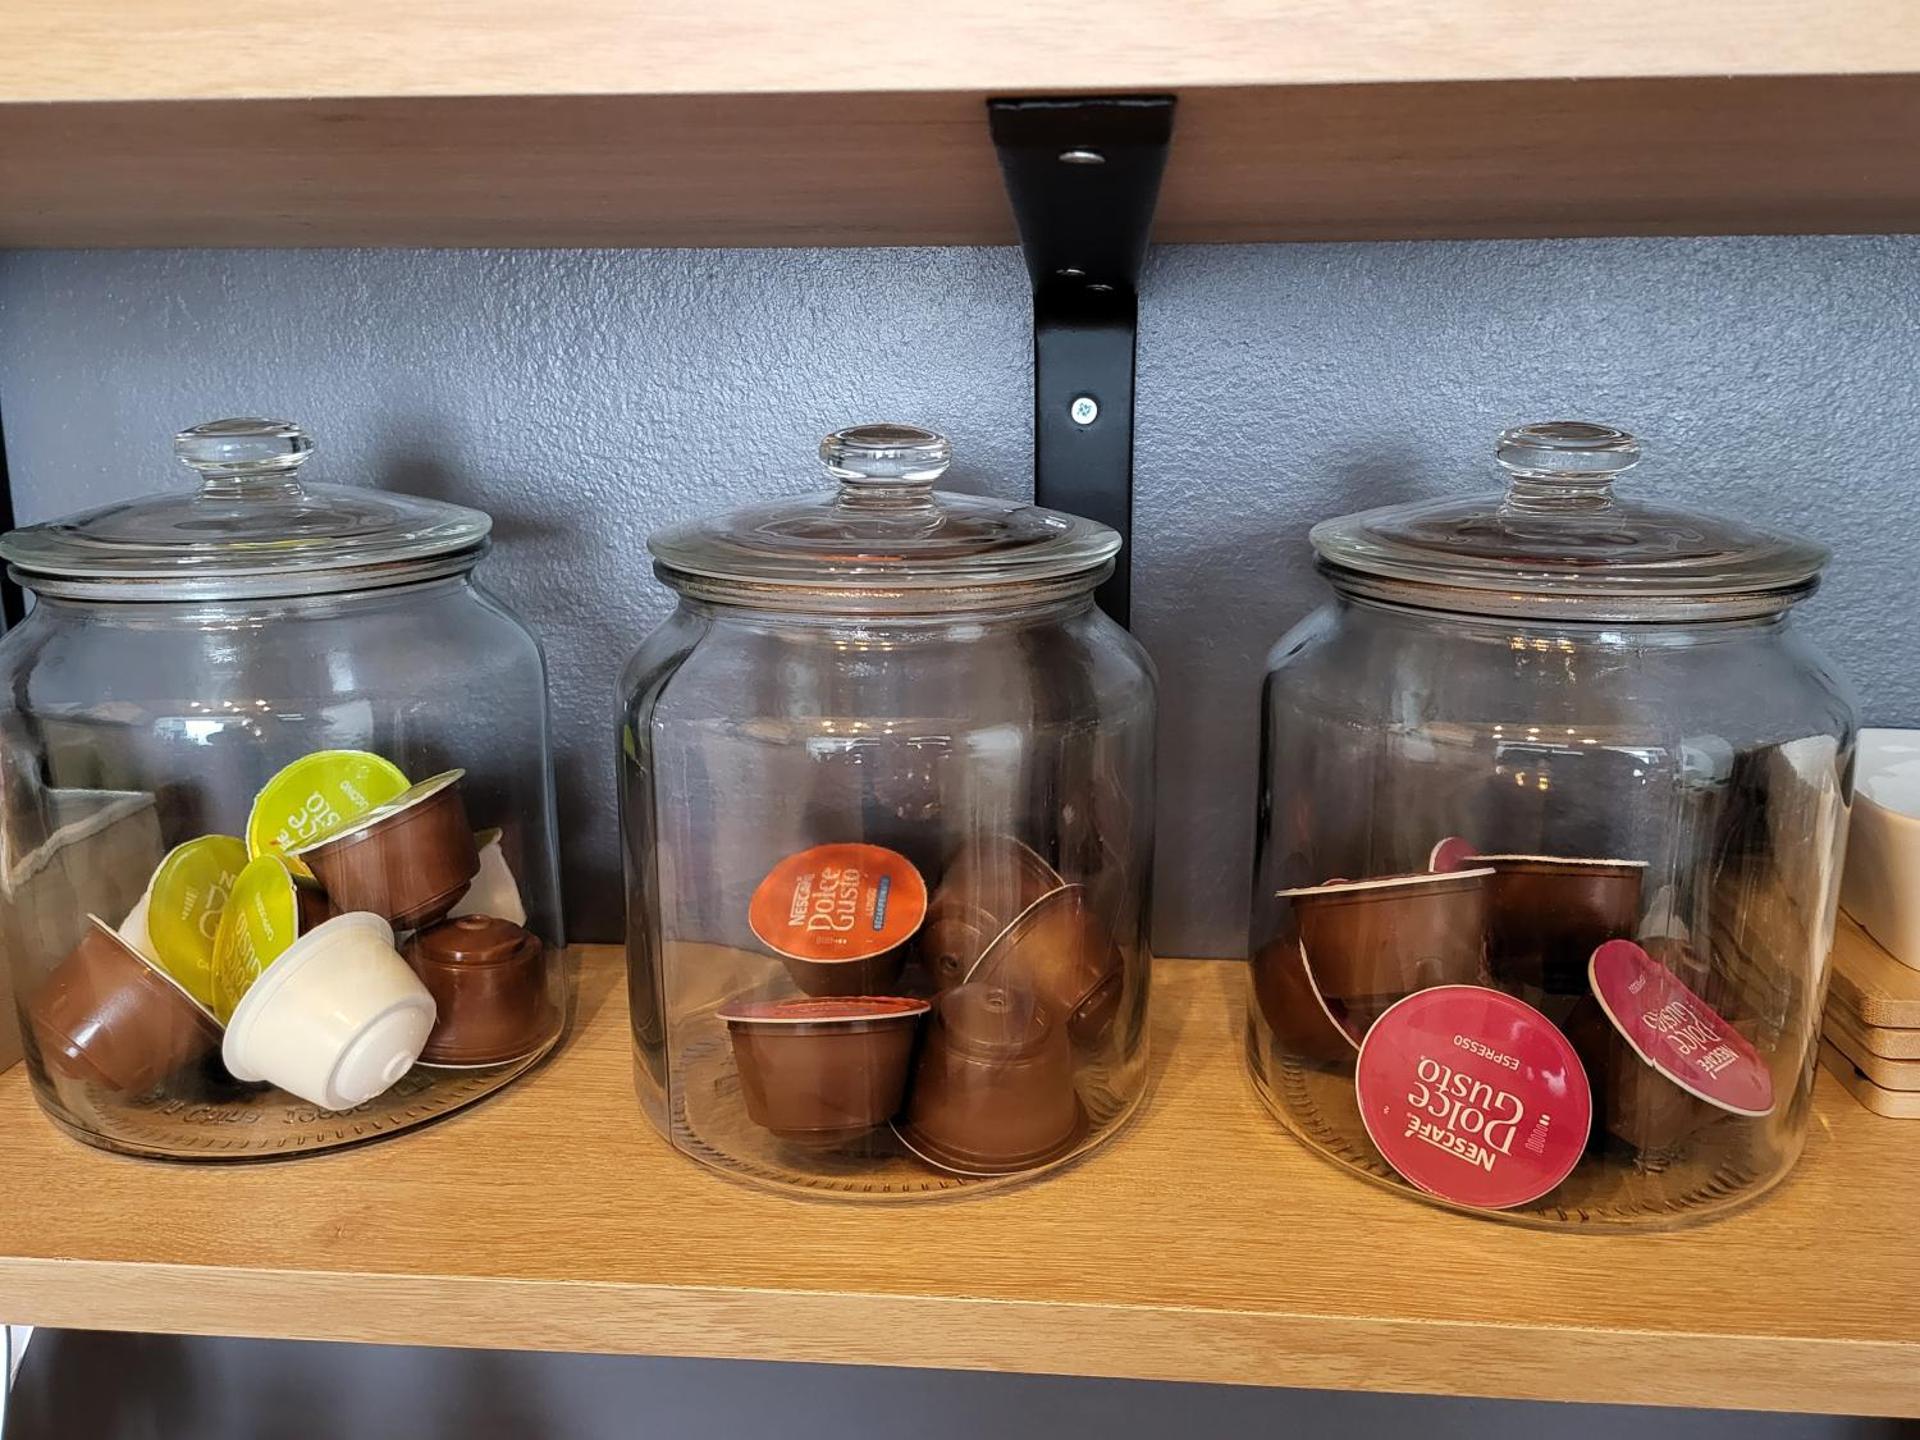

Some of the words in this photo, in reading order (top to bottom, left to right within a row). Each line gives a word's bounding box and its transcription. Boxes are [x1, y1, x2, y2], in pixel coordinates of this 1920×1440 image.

[807, 867, 842, 932] Dolce
[833, 868, 861, 931] Gusto
[1642, 1001, 1698, 1032] Gusto
[1668, 1021, 1721, 1055] Dolce
[1453, 1034, 1520, 1071] ESPRESSO
[1696, 1044, 1739, 1080] NESCAFÉ
[1407, 1082, 1518, 1157] Dolce
[1417, 1058, 1525, 1125] Gusto
[1404, 1115, 1497, 1173] NESCAFÉ
